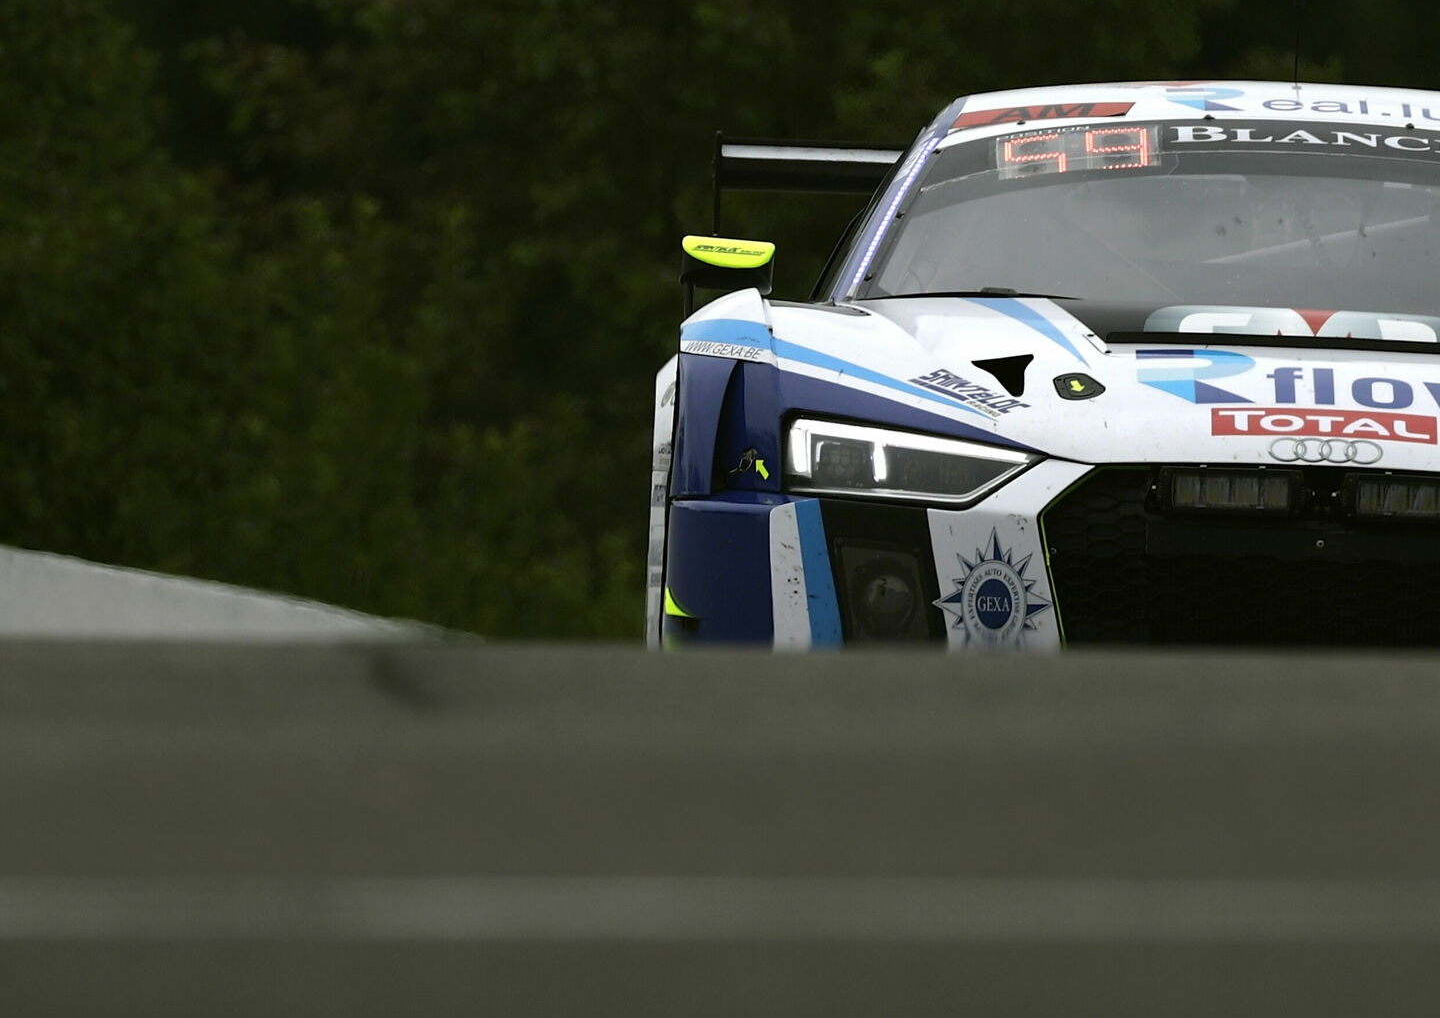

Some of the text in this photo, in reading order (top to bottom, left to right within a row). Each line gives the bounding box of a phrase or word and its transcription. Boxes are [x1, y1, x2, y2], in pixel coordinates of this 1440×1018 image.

[992, 102, 1096, 122] AM
[1005, 128, 1148, 173] 59
[685, 341, 764, 359] WWW.GEXA.BE
[1217, 410, 1430, 440] TOTAL
[984, 568, 1002, 576] AUTO
[977, 596, 1010, 612] GEXA
